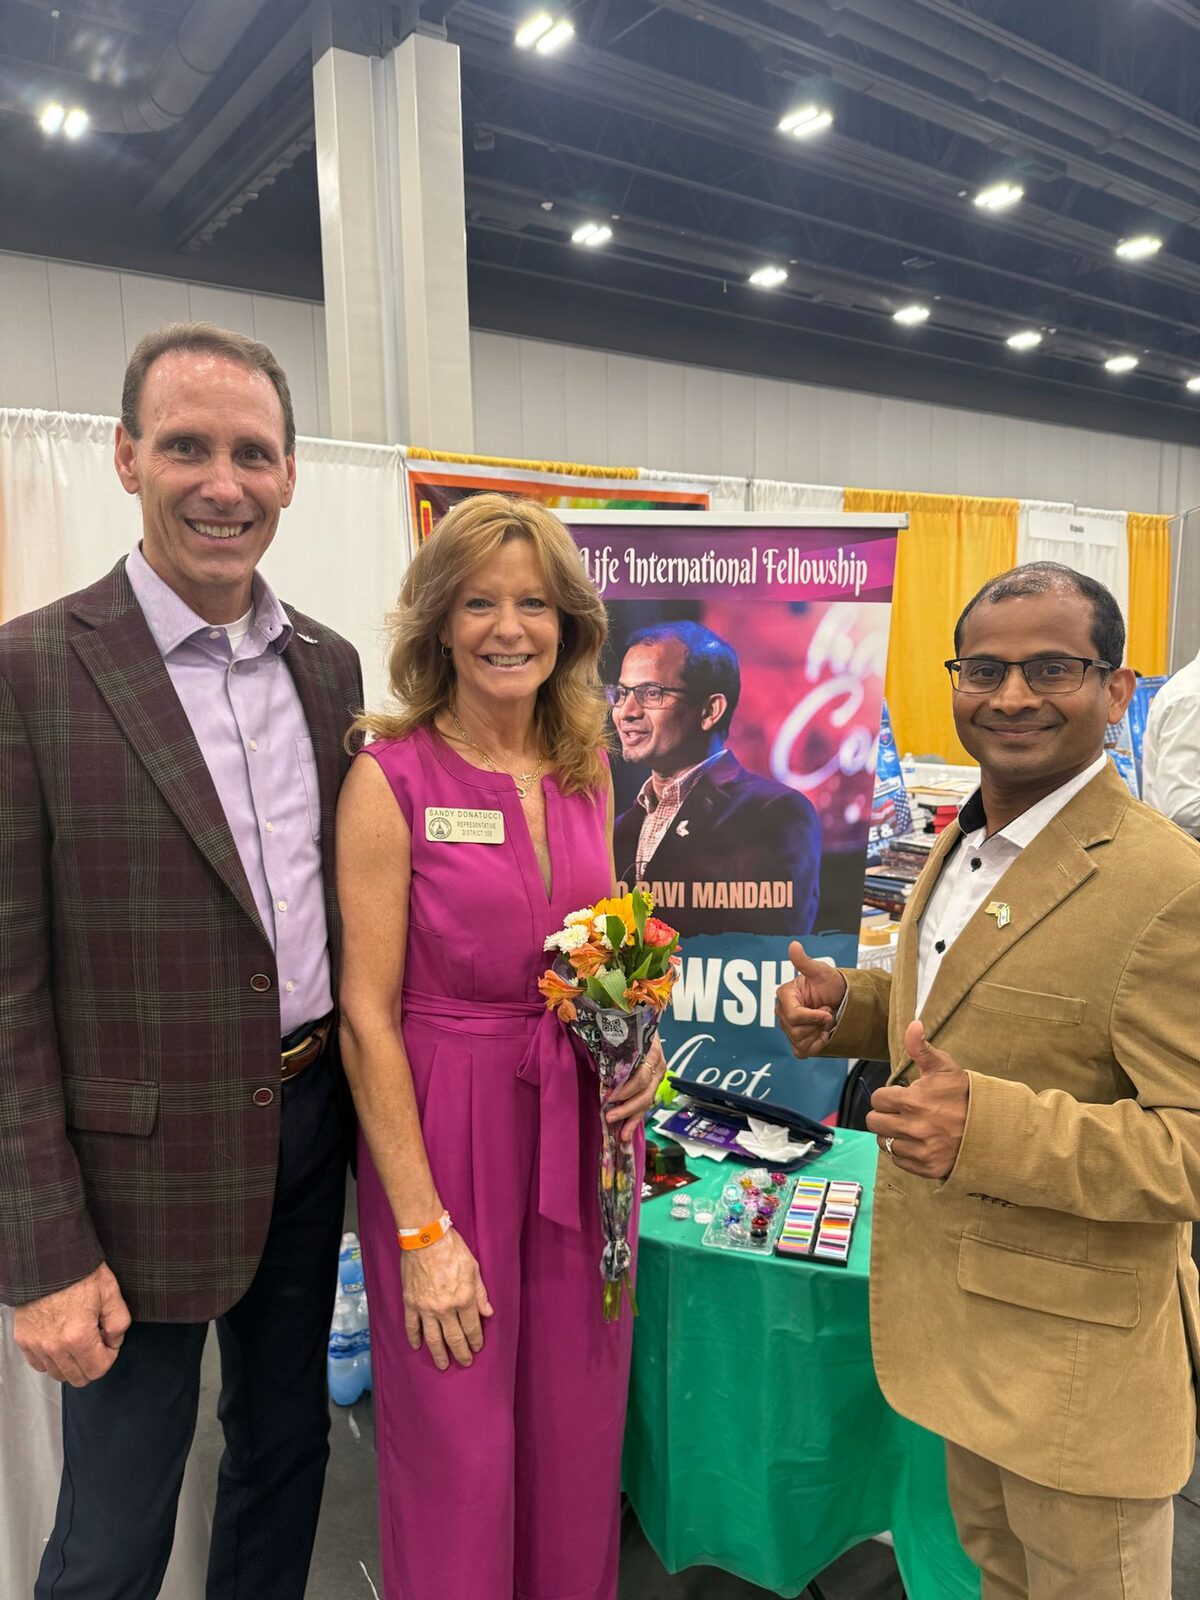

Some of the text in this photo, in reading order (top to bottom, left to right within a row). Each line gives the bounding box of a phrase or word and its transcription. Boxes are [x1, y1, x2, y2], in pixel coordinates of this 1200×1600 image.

[579, 545, 868, 596] Life International Fellowship
[429, 809, 501, 820] SANDY DONATUCCI
[457, 821, 496, 829] REPRESENTATIVE
[692, 881, 793, 909] MANDADI
